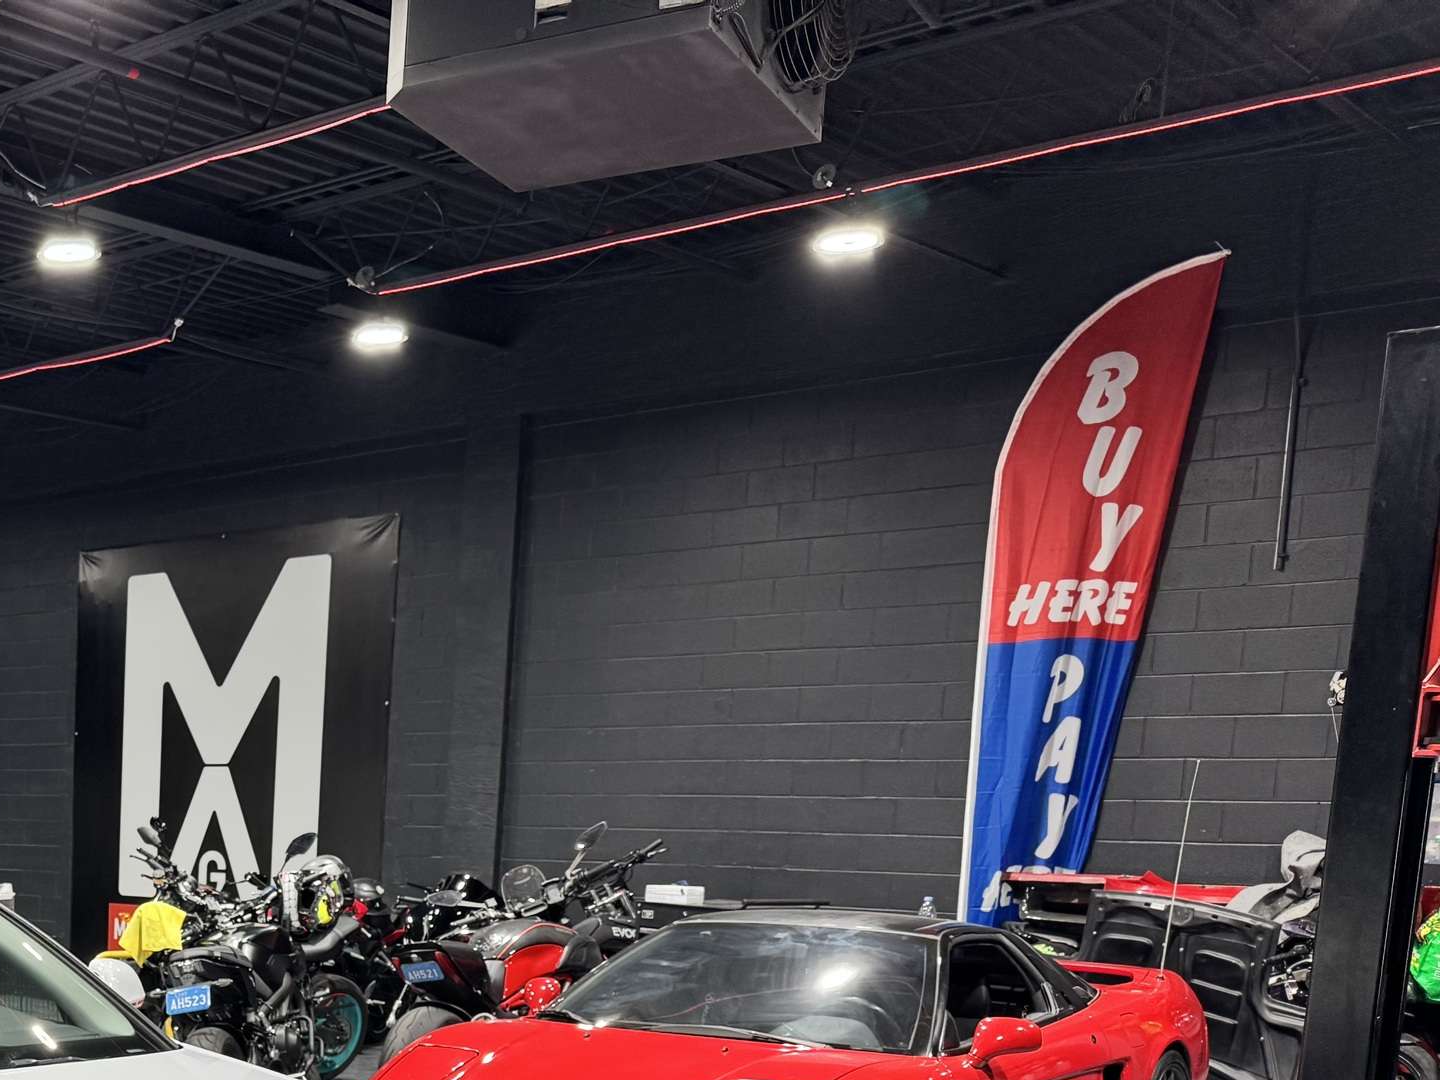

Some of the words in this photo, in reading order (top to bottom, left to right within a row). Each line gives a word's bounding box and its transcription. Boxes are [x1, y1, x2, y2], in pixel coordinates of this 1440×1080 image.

[1077, 351, 1144, 572] BUY
[1007, 579, 1138, 627] HERE
[1034, 654, 1079, 859] PAY
[170, 994, 207, 1010] AH523
